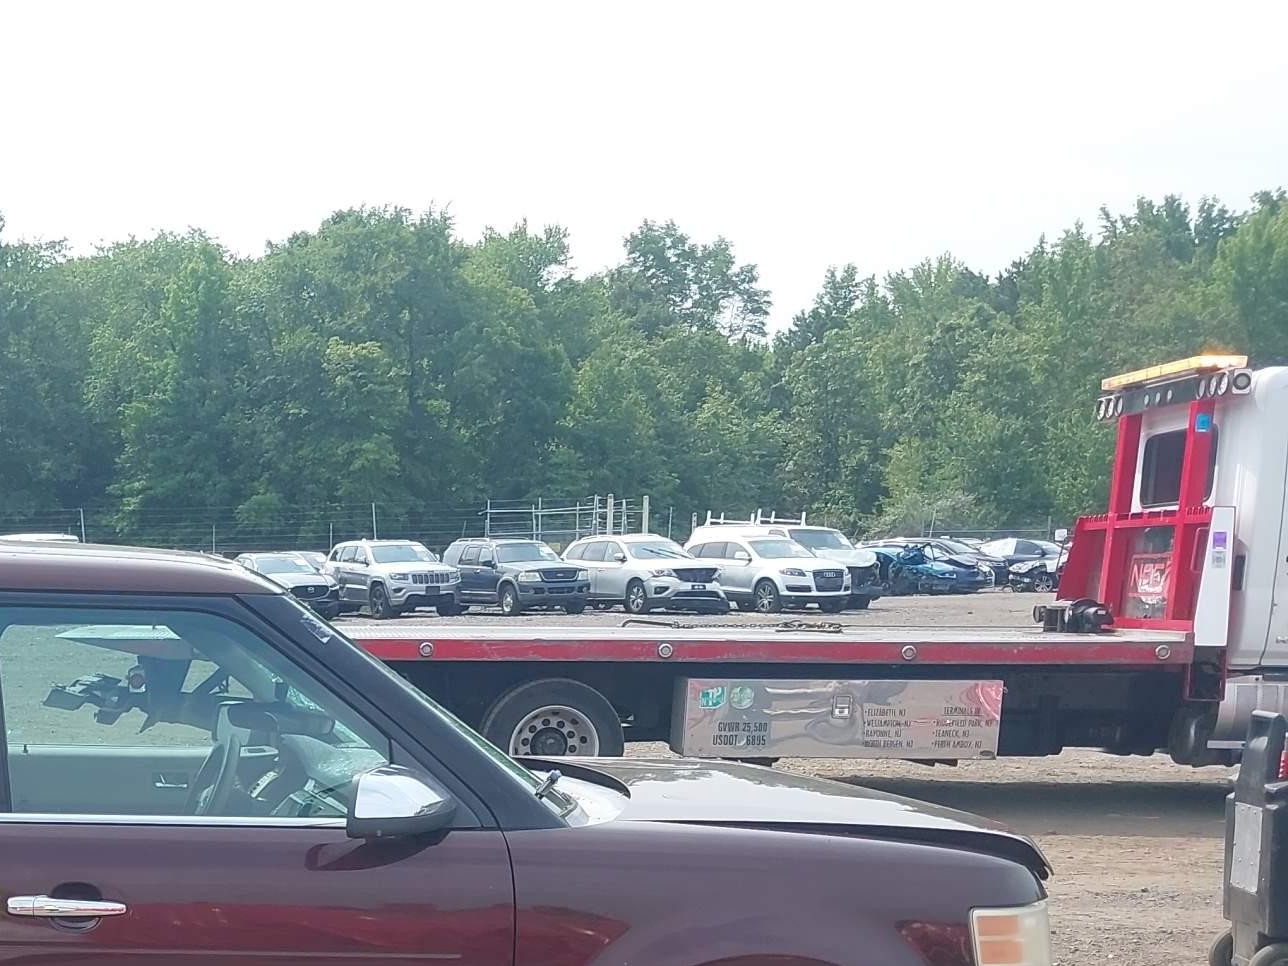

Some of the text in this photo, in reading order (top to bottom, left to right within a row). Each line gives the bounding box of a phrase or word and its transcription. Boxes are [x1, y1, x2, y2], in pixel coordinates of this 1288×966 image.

[718, 721, 768, 733] GVWR 25,500
[712, 734, 738, 746] USDOT
